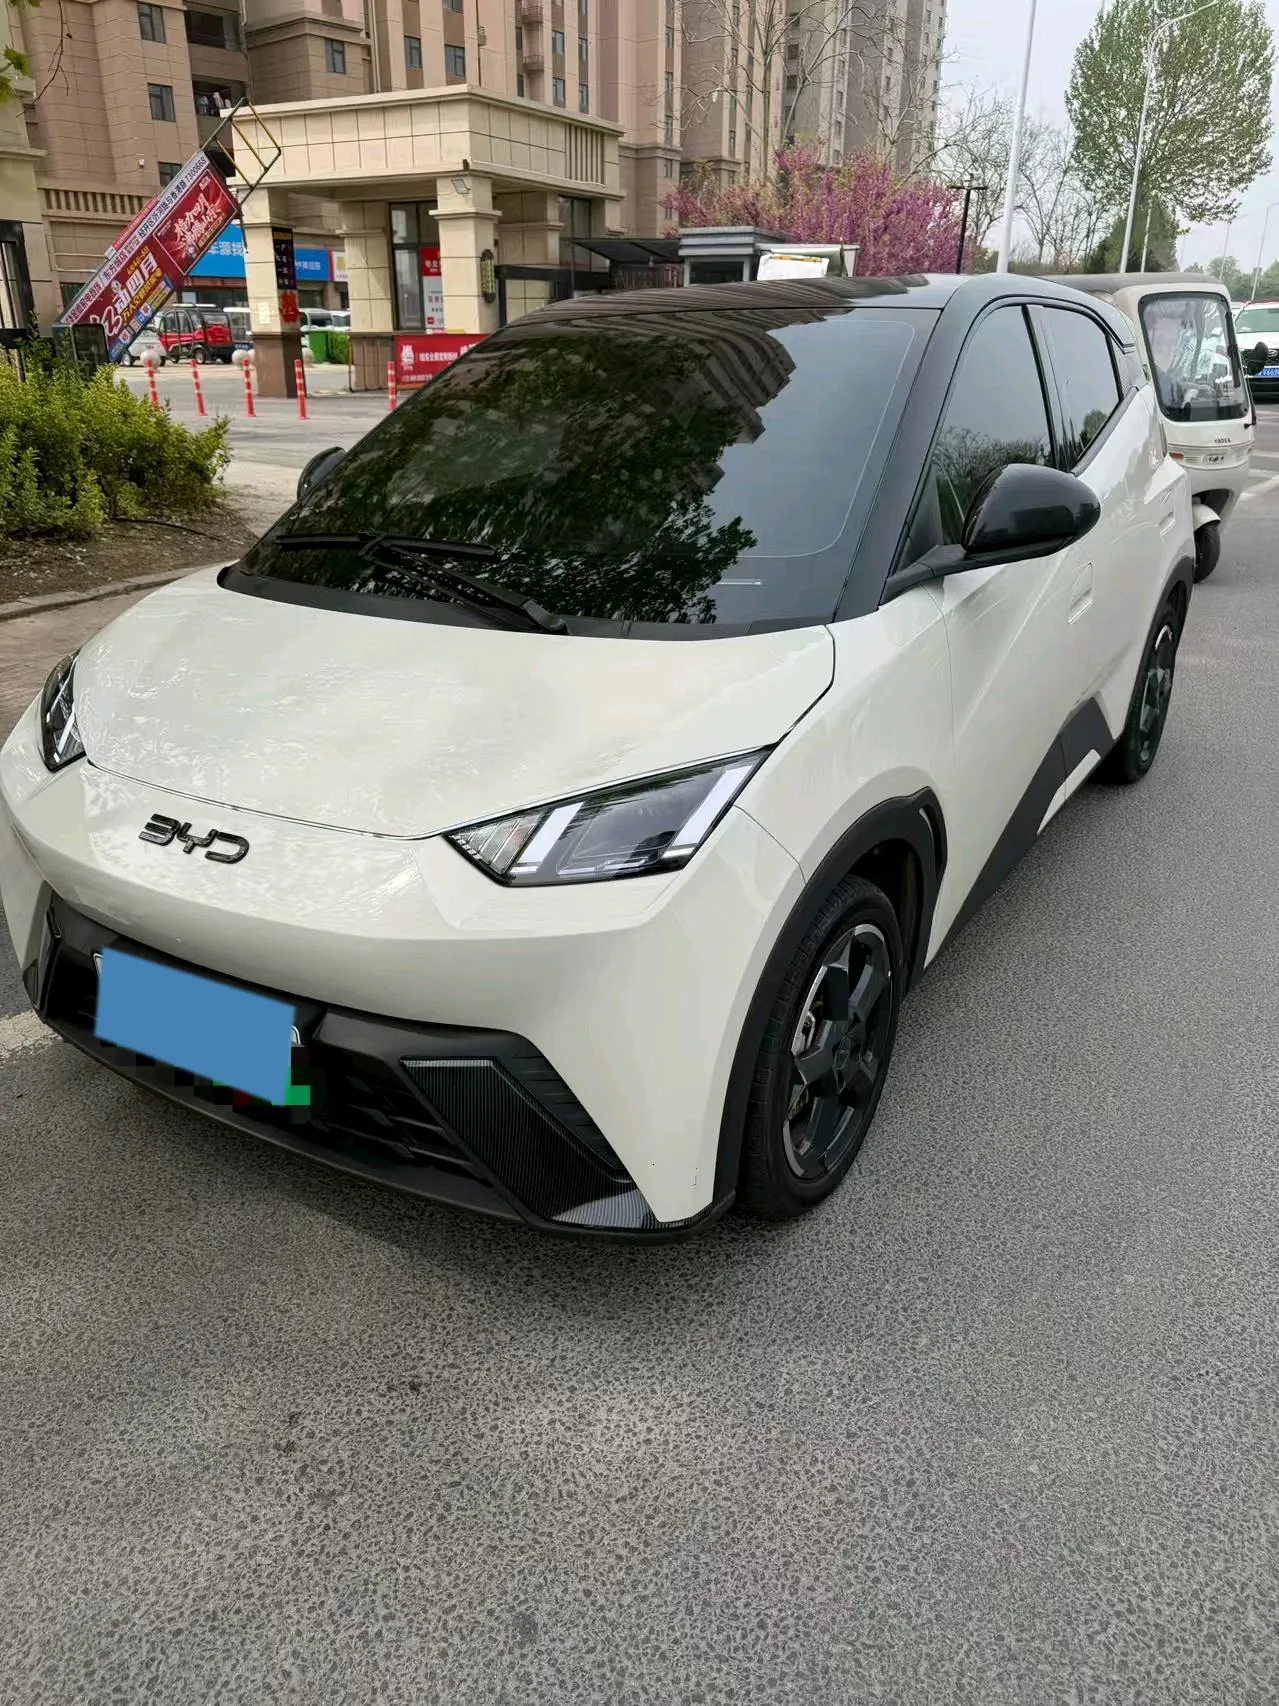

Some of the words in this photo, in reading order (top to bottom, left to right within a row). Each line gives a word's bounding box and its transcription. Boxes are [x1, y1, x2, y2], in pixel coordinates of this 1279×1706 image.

[170, 193, 211, 240] 格力四月
[139, 813, 250, 863] BYD
